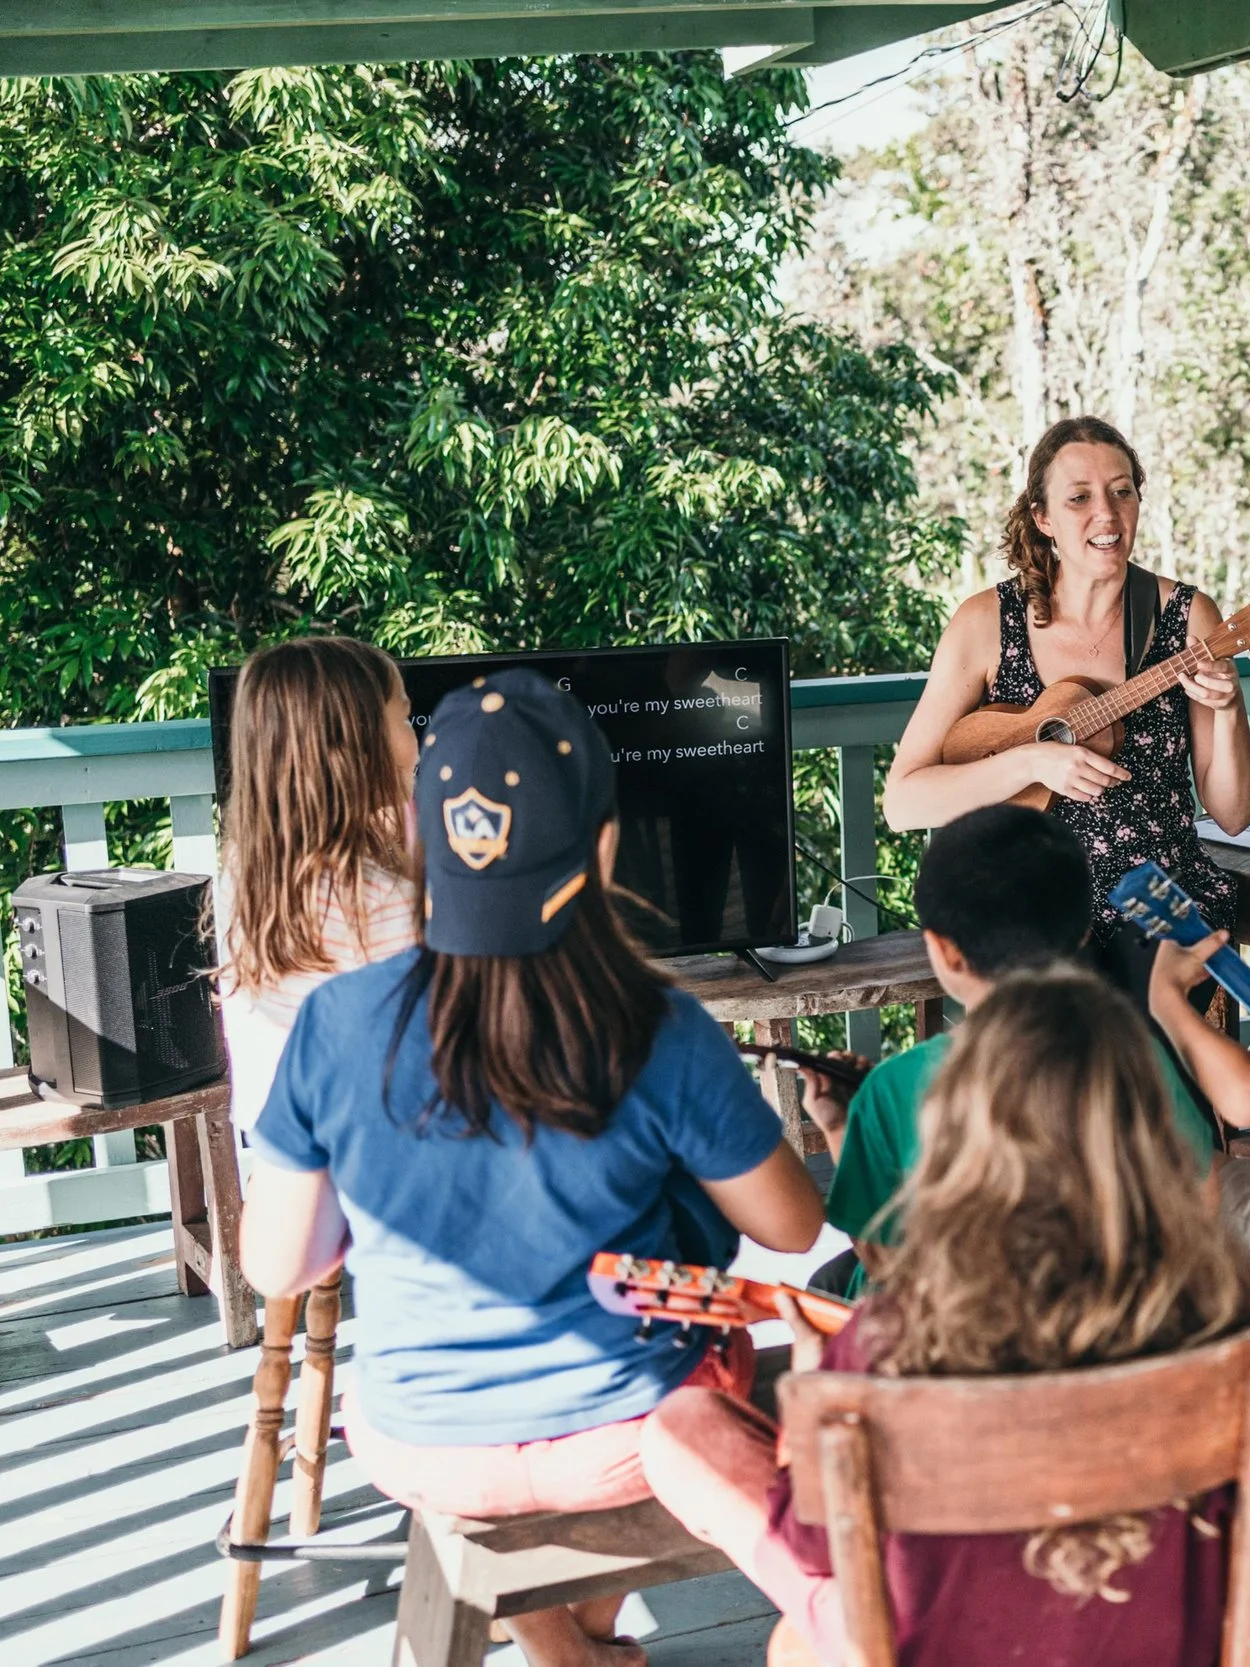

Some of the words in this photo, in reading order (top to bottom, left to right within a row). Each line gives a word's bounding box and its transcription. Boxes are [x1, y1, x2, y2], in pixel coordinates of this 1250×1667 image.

[557, 677, 571, 692] G
[735, 667, 748, 682] C
[587, 699, 640, 719] you're
[645, 699, 670, 715] my
[674, 692, 763, 711] sweetheart
[736, 715, 749, 730] C
[610, 747, 642, 763] u're
[647, 748, 671, 764] my
[676, 740, 765, 759] sweetheart
[455, 812, 498, 840] LA
